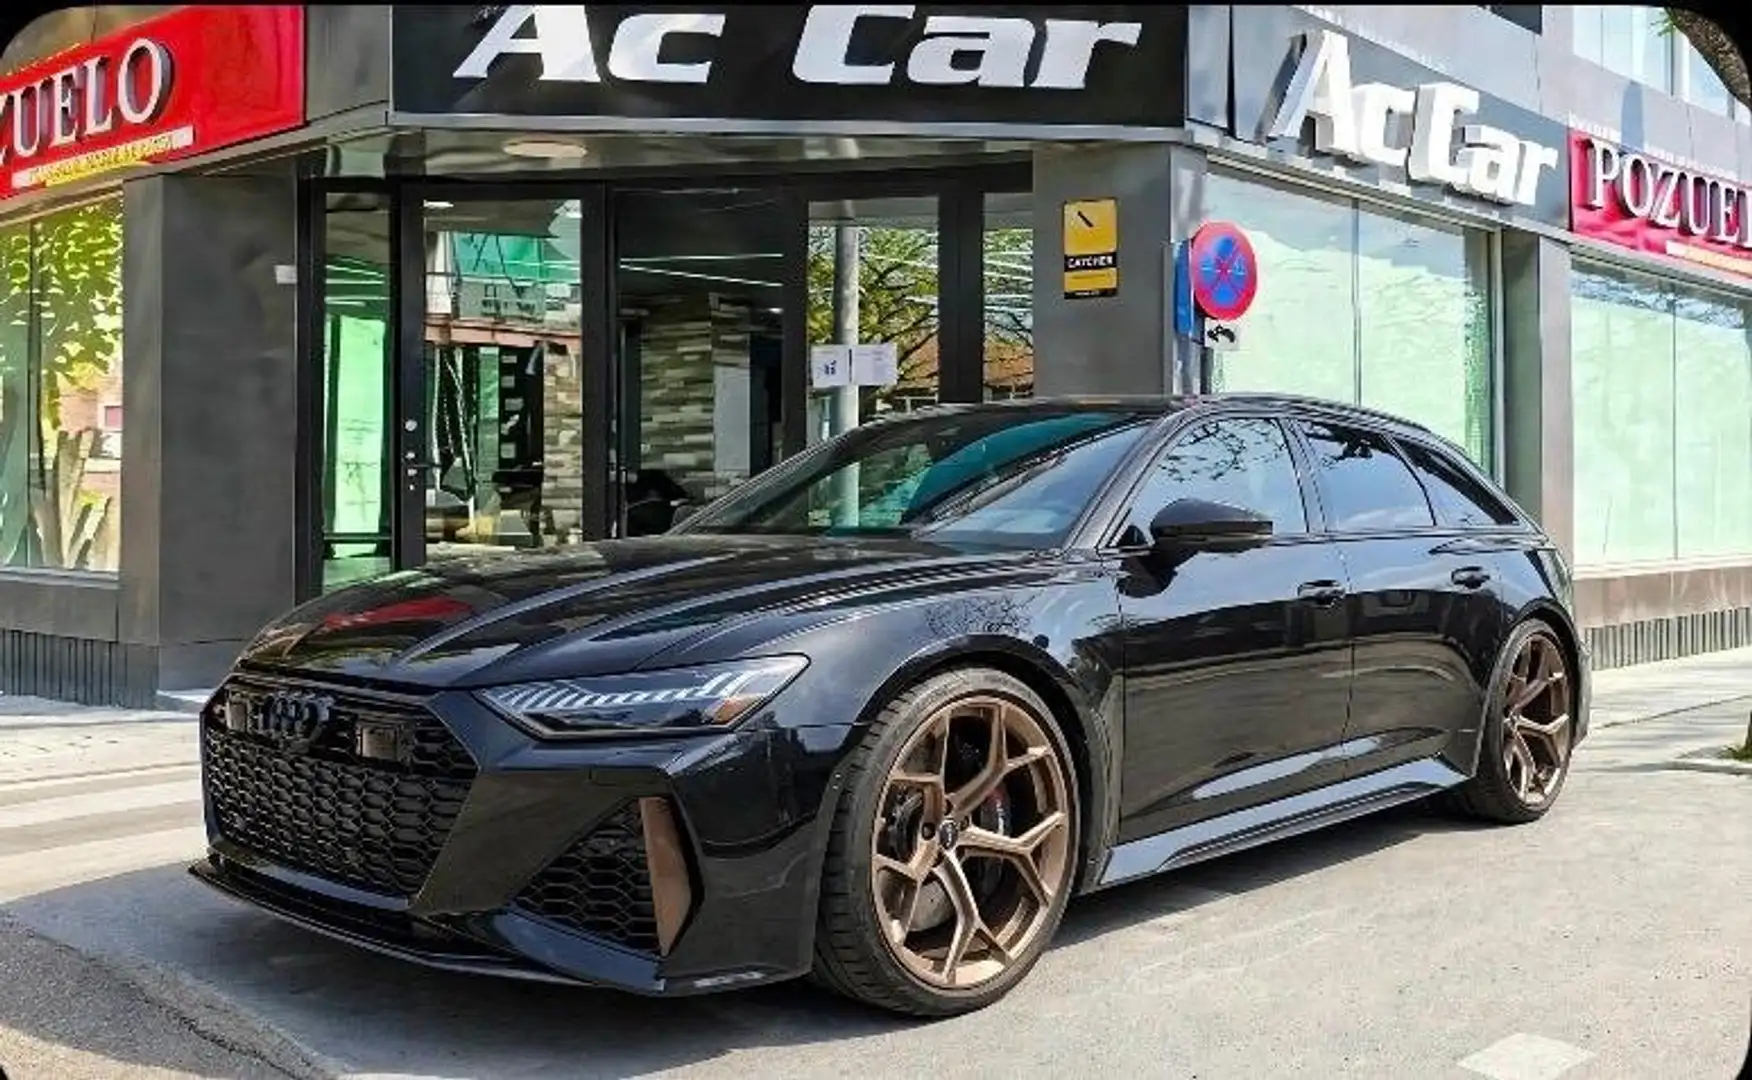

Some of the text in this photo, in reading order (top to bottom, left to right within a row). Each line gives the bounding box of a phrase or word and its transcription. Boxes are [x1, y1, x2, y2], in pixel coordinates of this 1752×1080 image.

[452, 4, 1143, 90] Ac Car
[0, 38, 168, 165] UELO
